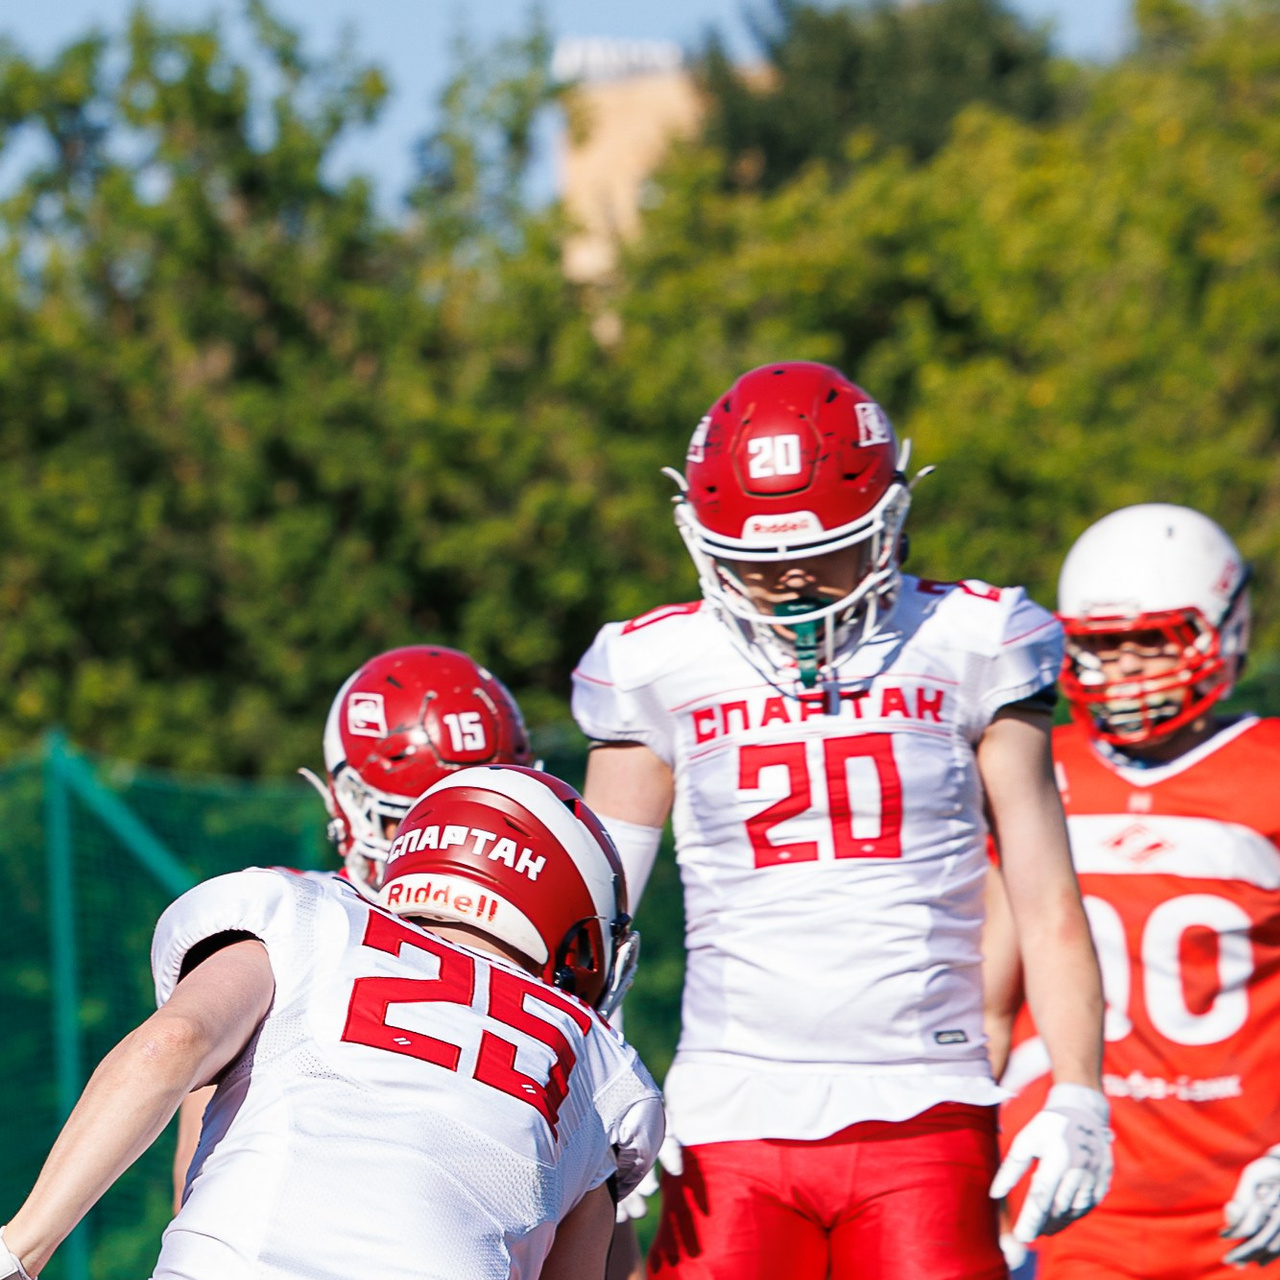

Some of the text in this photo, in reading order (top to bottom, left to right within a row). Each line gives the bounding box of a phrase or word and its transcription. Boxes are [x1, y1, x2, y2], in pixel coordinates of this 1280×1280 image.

[747, 434, 802, 479] 20
[443, 711, 487, 752] 15
[738, 733, 903, 869] 20
[386, 825, 548, 881] СПАРТАК
[387, 882, 500, 923] Riddell
[340, 908, 577, 1144] 25
